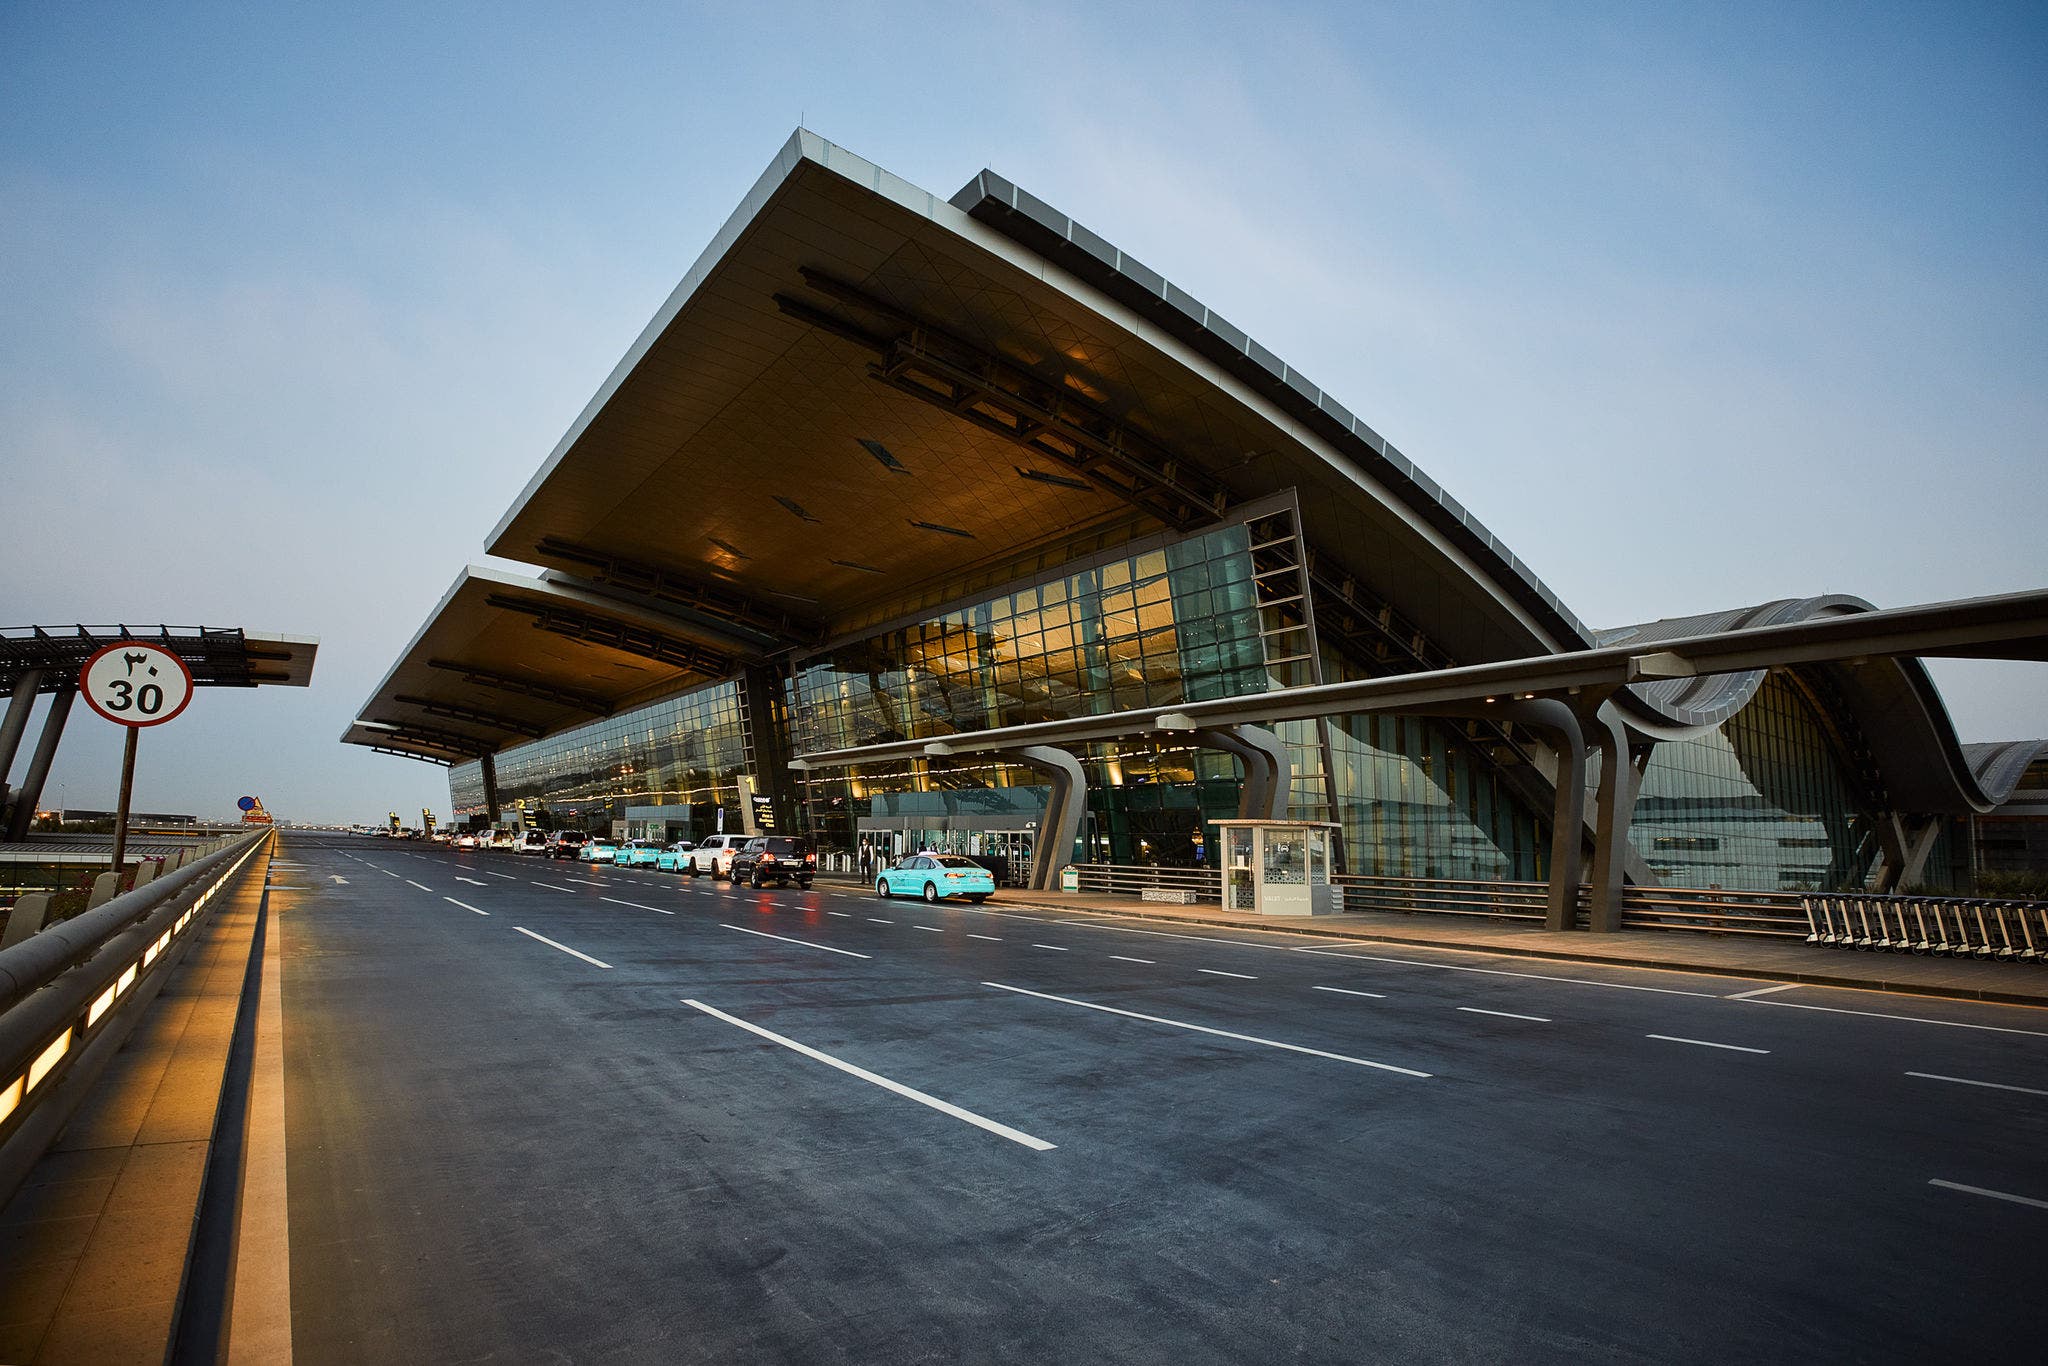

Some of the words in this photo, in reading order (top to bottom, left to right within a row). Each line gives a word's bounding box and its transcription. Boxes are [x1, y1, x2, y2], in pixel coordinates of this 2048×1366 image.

[123, 651, 158, 677] ٣٠
[105, 680, 163, 714] 30
[745, 776, 755, 793] 1
[518, 799, 526, 809] 2
